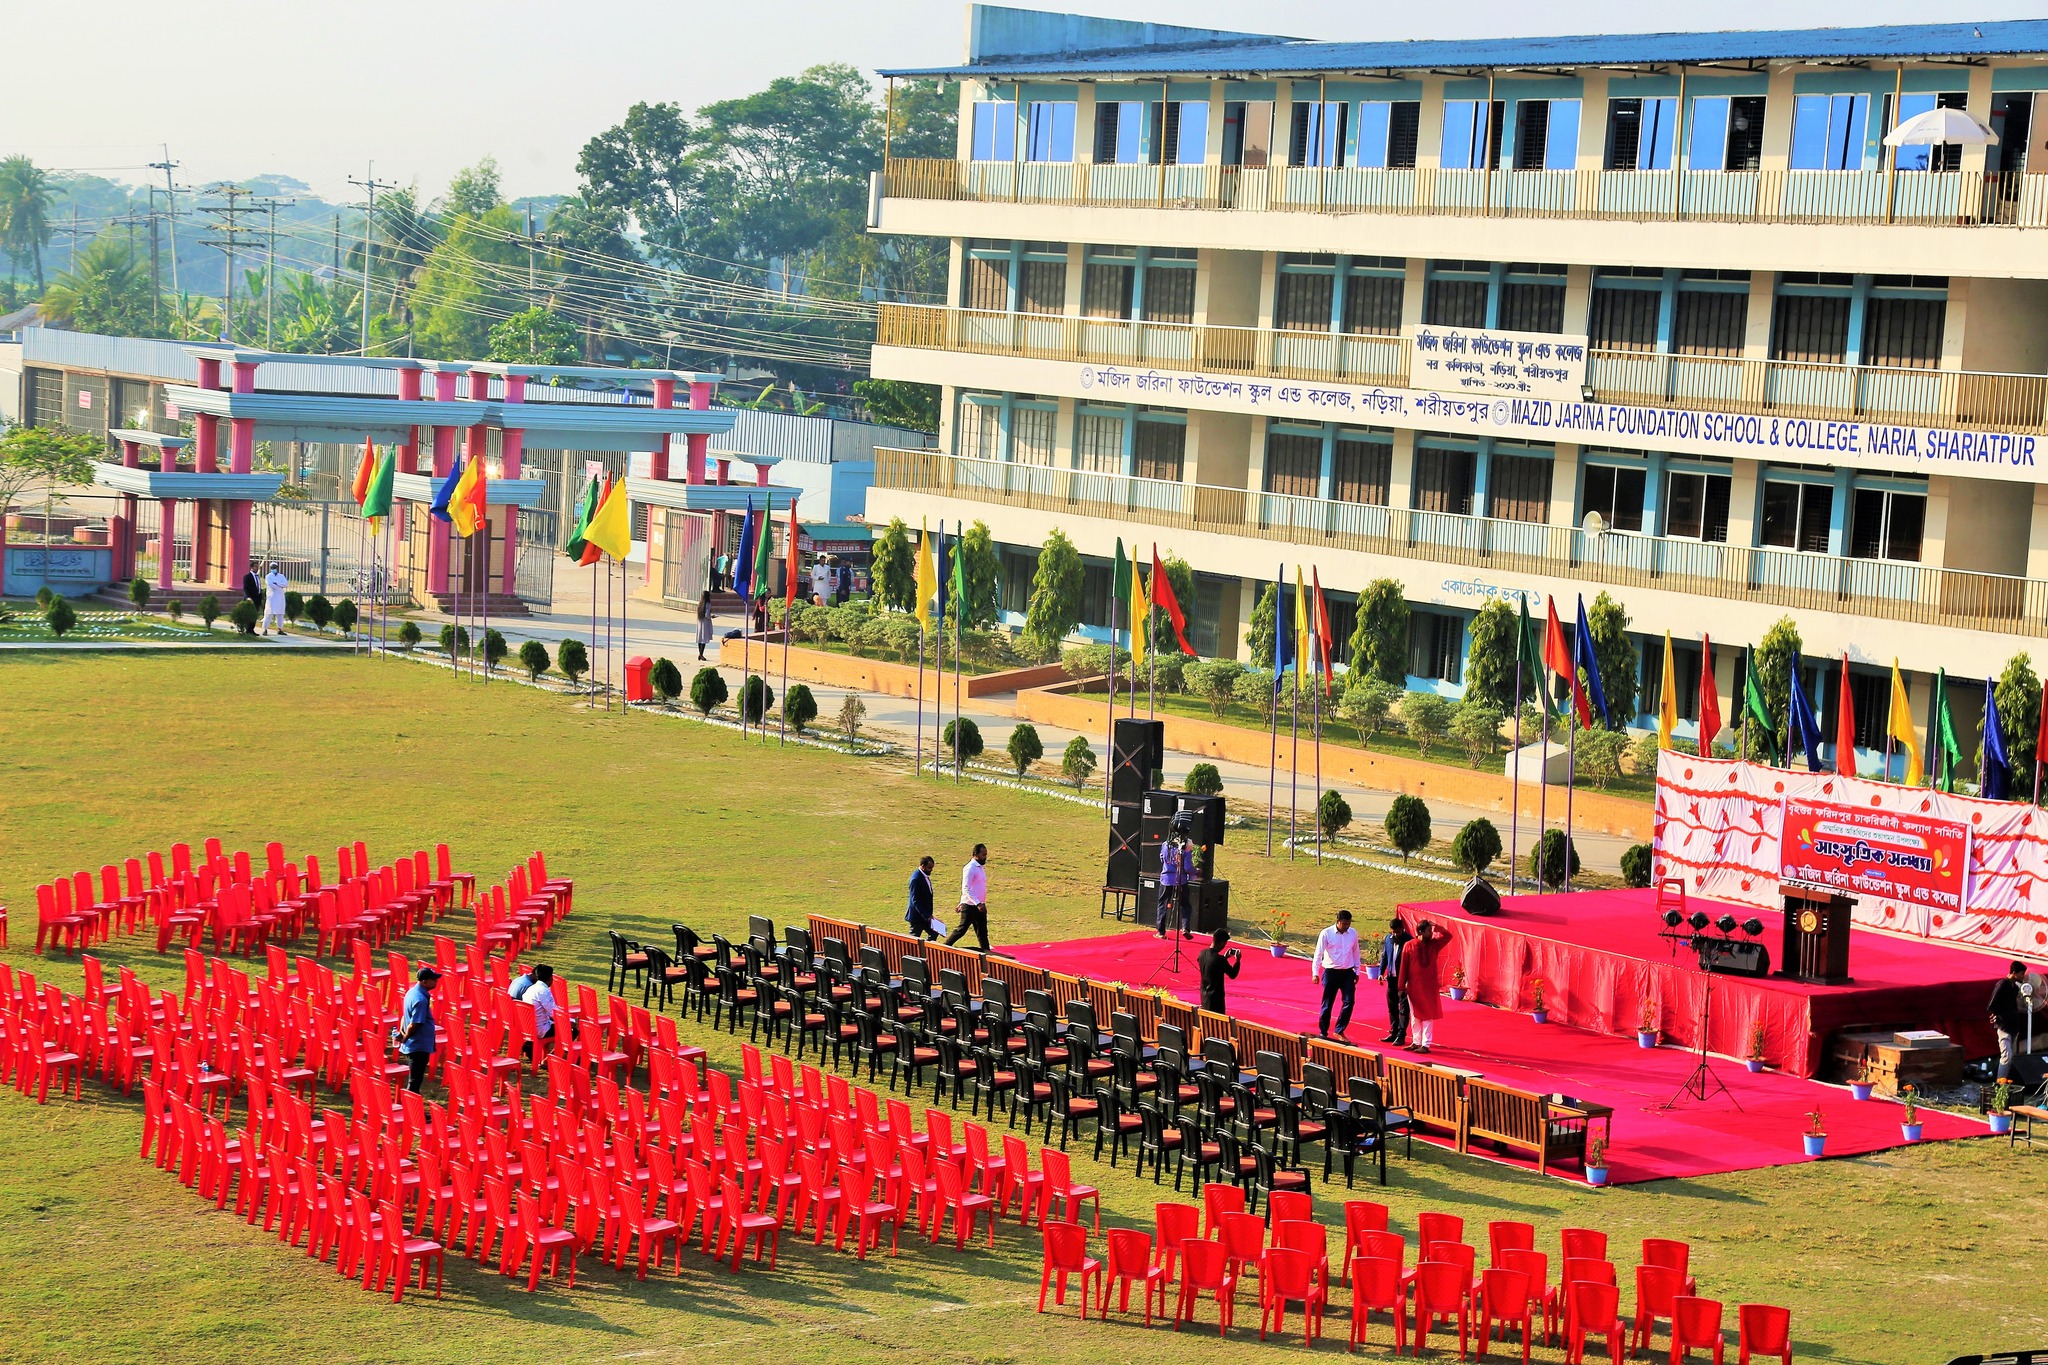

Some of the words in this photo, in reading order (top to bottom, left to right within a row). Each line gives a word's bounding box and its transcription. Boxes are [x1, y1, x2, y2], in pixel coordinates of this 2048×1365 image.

[1417, 329, 1439, 352] মজিদ
[1443, 330, 1467, 354] জরিনা
[1517, 342, 1533, 363] স্কুল
[1555, 344, 1583, 363] কলেজ
[1523, 363, 1569, 382] শরীয়তপুর
[1098, 367, 1131, 389] মজিদ
[1136, 371, 1172, 393] জরিনা
[1178, 375, 1242, 400] ফাউন্ডেশন
[1248, 384, 1271, 405] স্কুল
[1278, 386, 1302, 403] এন্ড
[1308, 388, 1355, 411] কলেজ,
[1362, 389, 1408, 416] নড়িয়া,
[1415, 392, 1489, 424] শরীয়তপুর
[1511, 399, 1552, 427] MAZID
[1555, 403, 1604, 432] JARINA
[1609, 407, 1700, 439] FOUNDATION
[1703, 413, 1765, 445] SCHOOL
[1769, 420, 1779, 444] &
[1785, 419, 1862, 456] COLLEGE,
[1867, 427, 1922, 463] NARIA,
[1925, 430, 2036, 467] SHARIATPUR
[1441, 578, 1498, 598] একাডেমিক
[1788, 804, 1813, 817] বৃহত্তর
[1816, 808, 1851, 822] ফরিদপুর
[1854, 814, 1900, 829] চাকরিজীবী
[1903, 821, 1932, 834] কল্যাণ
[1935, 826, 1963, 840] সমিতি
[1797, 864, 1822, 882] মজিদ
[1824, 868, 1850, 887] জরিনা
[1852, 873, 1893, 895] ফাউন্ডেশন
[1895, 881, 1911, 901] স্কুল
[1932, 890, 1958, 908] কলেজ
